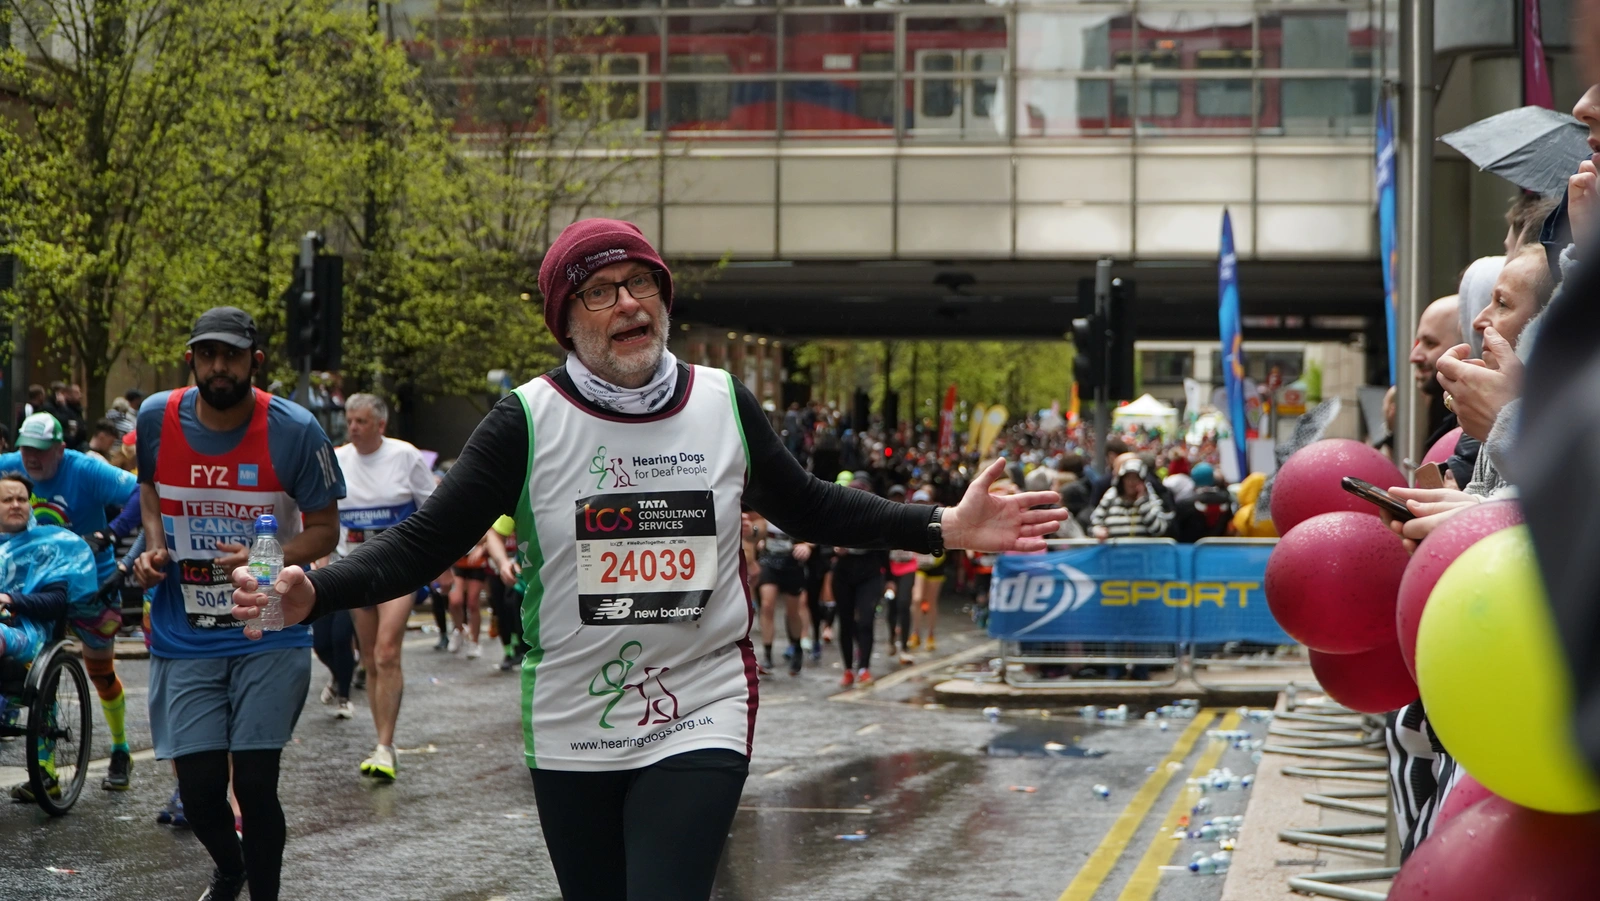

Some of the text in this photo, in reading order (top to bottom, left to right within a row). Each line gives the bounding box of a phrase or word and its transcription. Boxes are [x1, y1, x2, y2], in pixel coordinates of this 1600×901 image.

[585, 248, 626, 263] Hearing Dogs
[609, 253, 628, 261] People
[632, 452, 706, 467] Hearing Dogs
[190, 464, 230, 487] FYZ
[634, 464, 708, 480] for Deaf People
[187, 501, 274, 520] TEENAGE
[637, 499, 669, 509] TATA
[584, 503, 634, 533] tcs
[638, 508, 708, 521] CONSULTANCY
[190, 518, 255, 536] CANCE
[638, 520, 684, 531] SERVICES
[183, 563, 210, 582] tcs
[600, 548, 696, 584] 24039
[195, 590, 237, 608] 5047
[1101, 581, 1258, 607] SPORT
[634, 606, 705, 618] new balance
[570, 715, 715, 751] www.hearingdogs.org.uk
